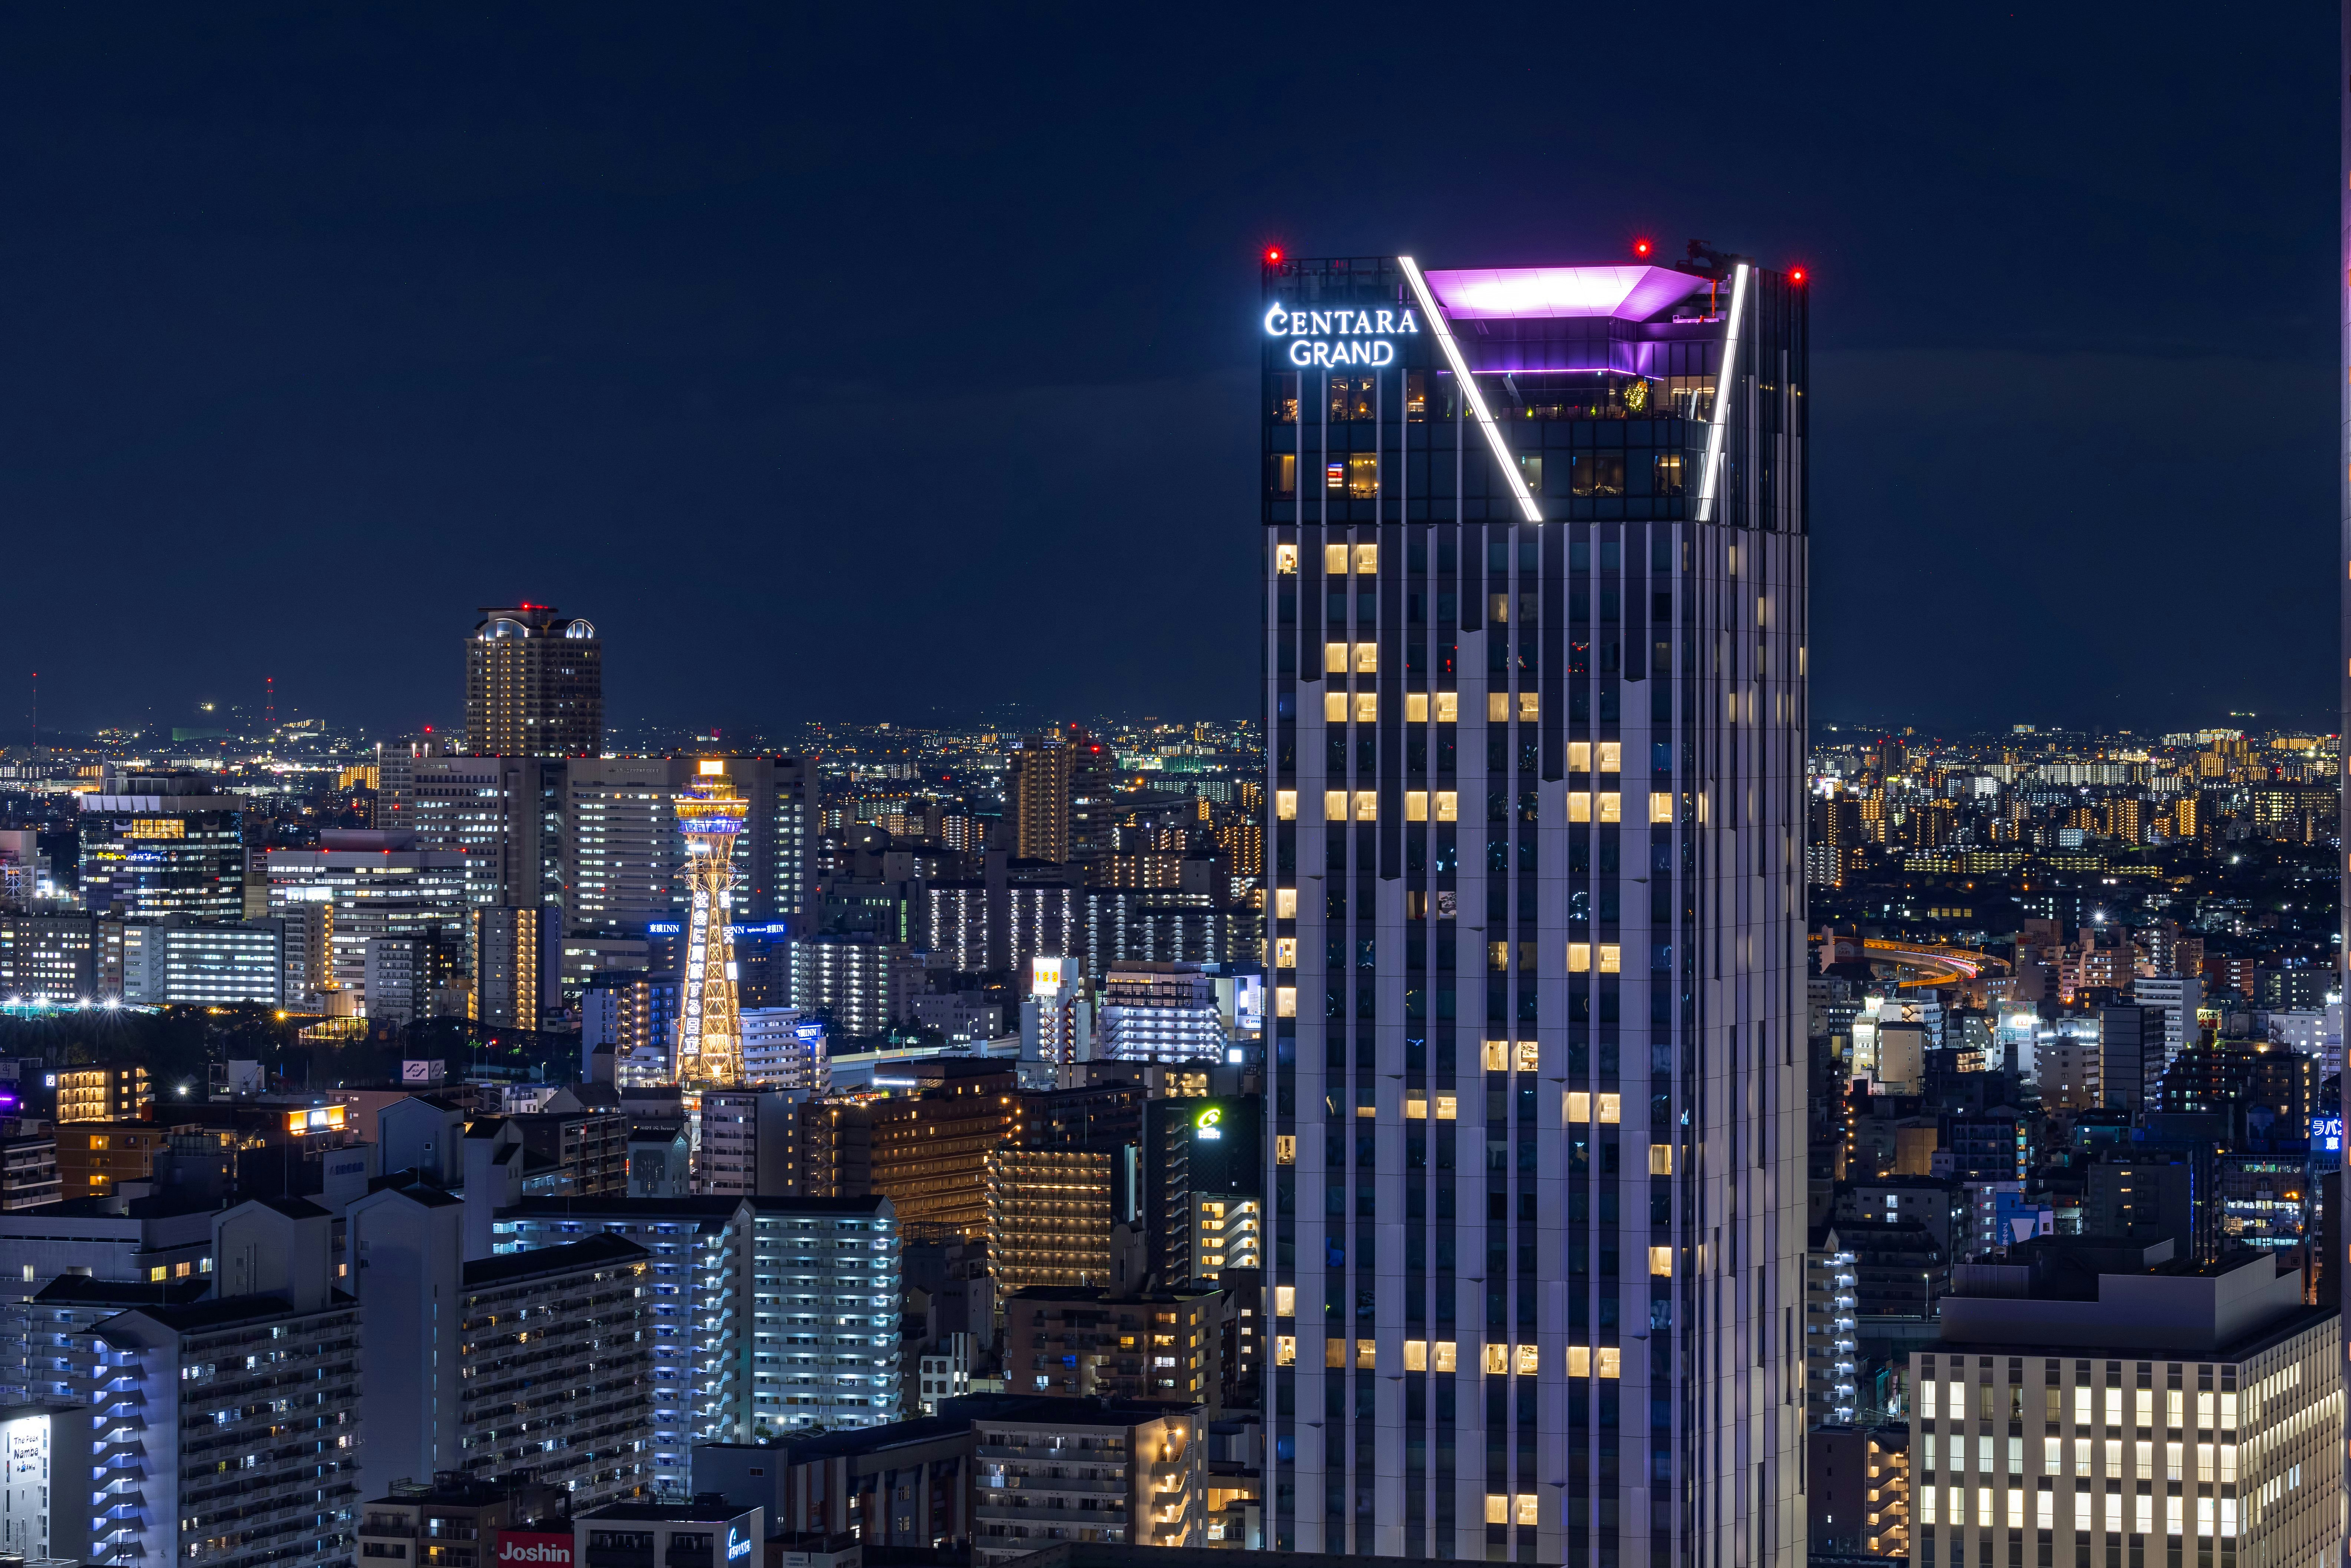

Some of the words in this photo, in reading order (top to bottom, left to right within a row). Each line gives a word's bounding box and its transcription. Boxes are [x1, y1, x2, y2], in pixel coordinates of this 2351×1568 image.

[1265, 302, 1418, 336] CENTARA
[1290, 340, 1393, 368] GRAND
[650, 924, 679, 932] 東横INN
[1035, 971, 1058, 982] 123
[14, 1437, 25, 1445] The
[14, 1447, 38, 1460] Namba
[499, 1542, 569, 1562] Joshin
